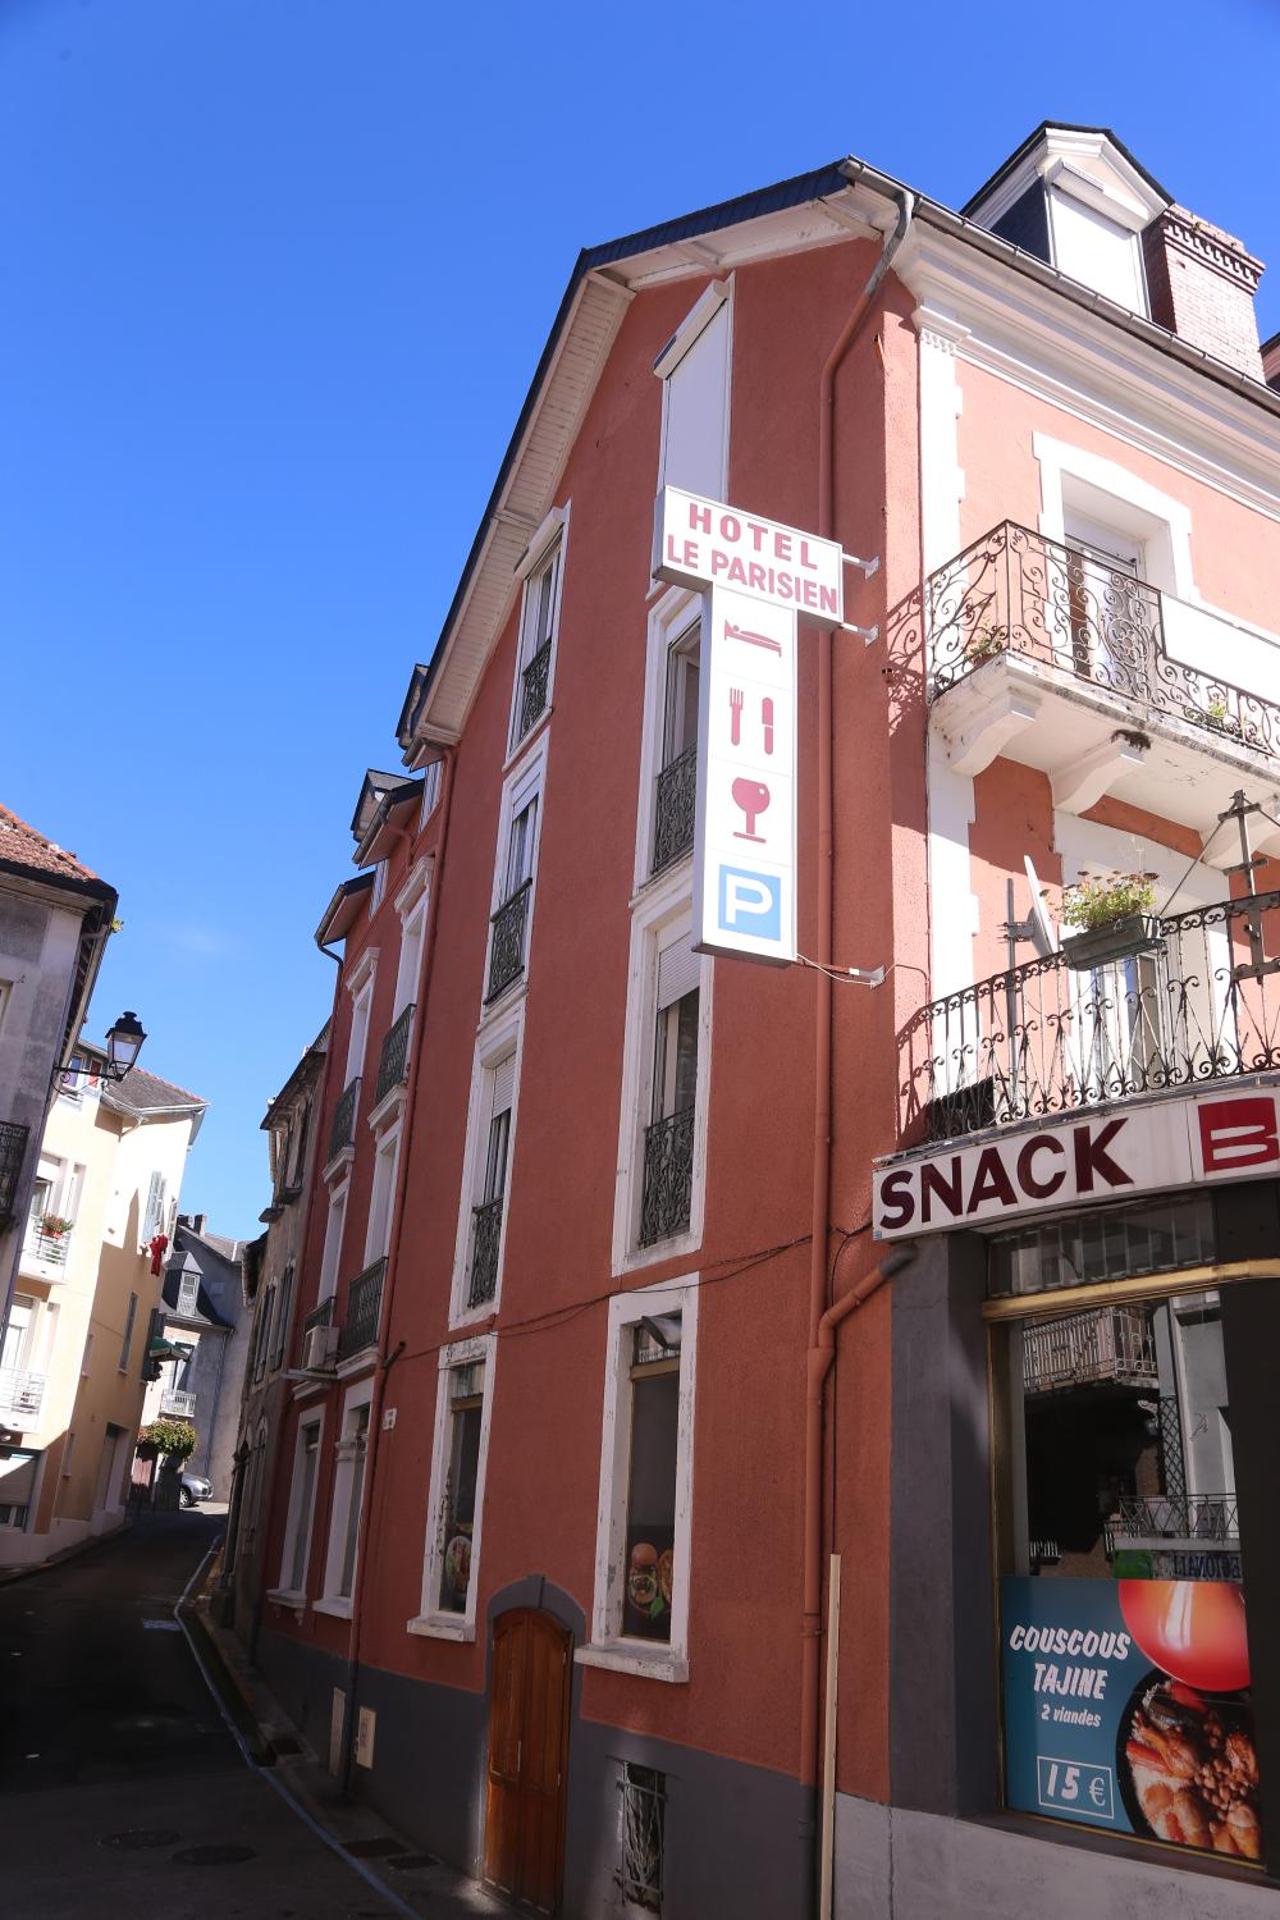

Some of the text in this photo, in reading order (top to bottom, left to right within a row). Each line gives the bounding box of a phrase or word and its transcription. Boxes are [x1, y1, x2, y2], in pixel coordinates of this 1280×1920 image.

[689, 502, 818, 570] HOTEL
[667, 534, 838, 614] LE PARISIEN
[725, 873, 773, 925] P
[880, 1117, 1135, 1229] SNACK
[1009, 1624, 1131, 1660] COUSCOUS
[1033, 1662, 1108, 1700] TAJINE
[1041, 1703, 1101, 1728] 2 viandes
[1046, 1763, 1106, 1807] 15 €
